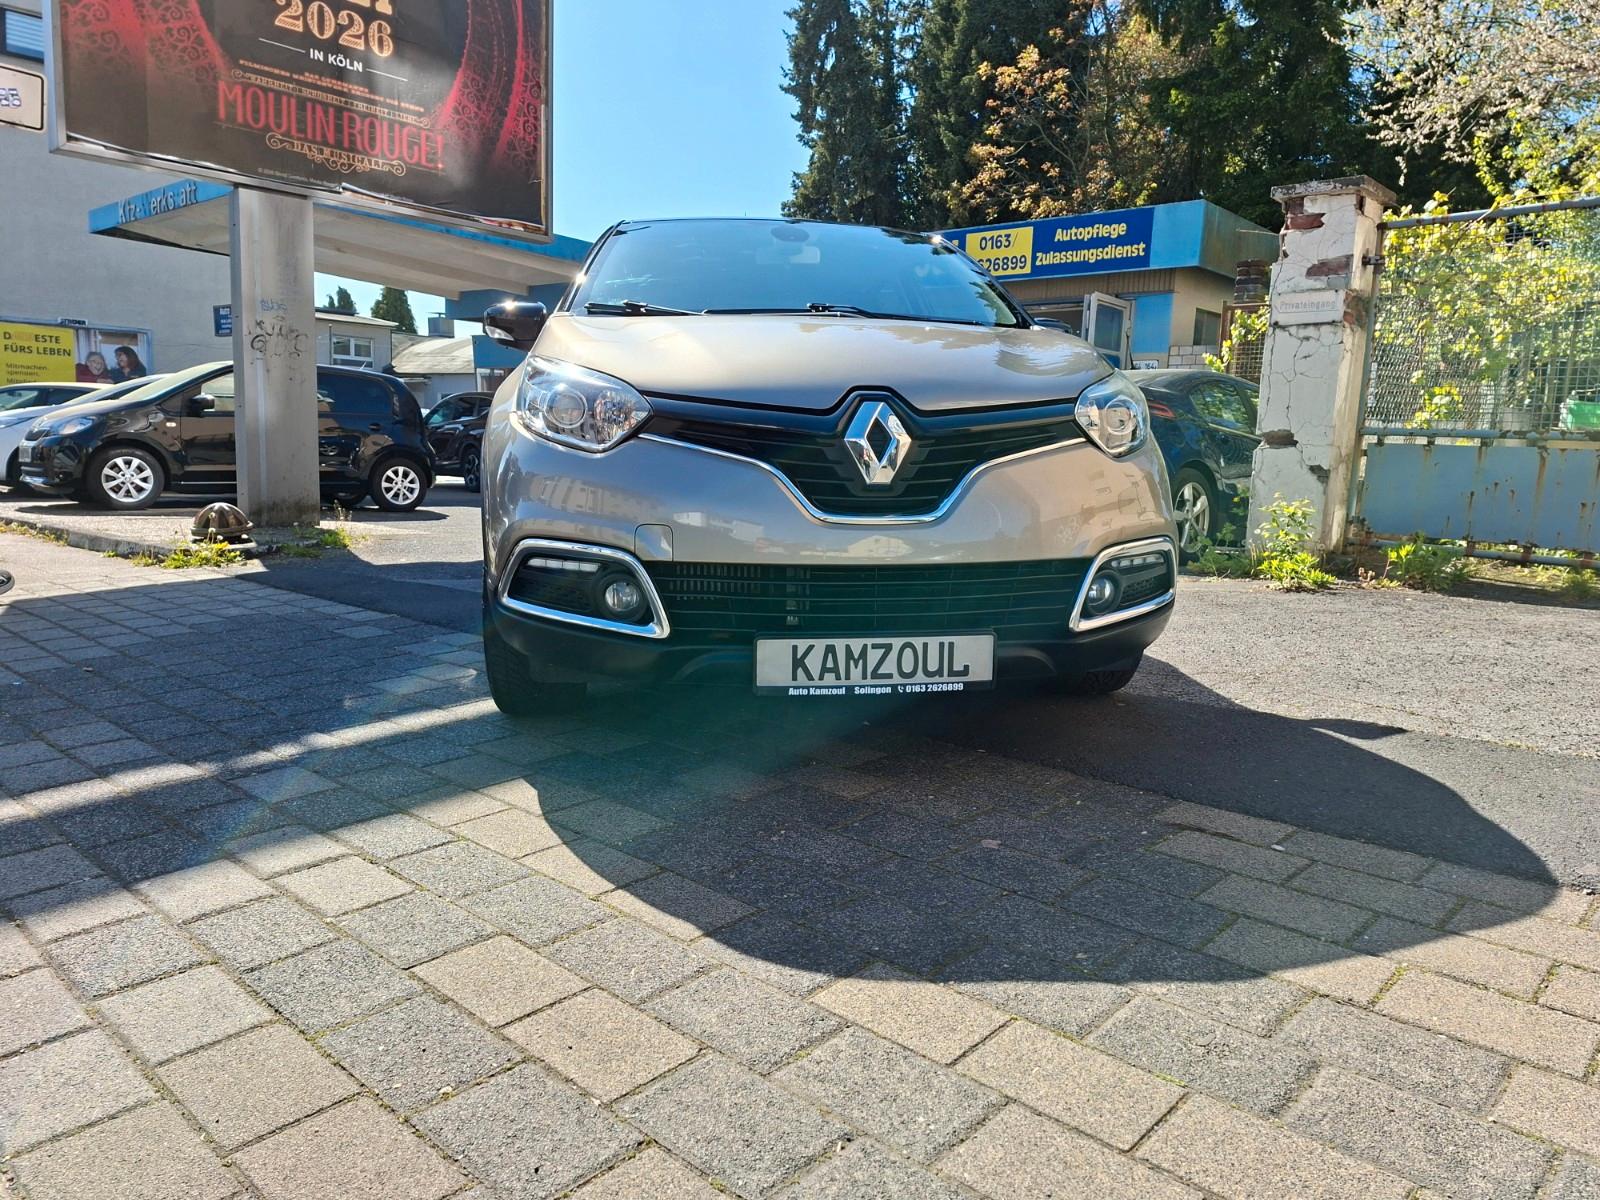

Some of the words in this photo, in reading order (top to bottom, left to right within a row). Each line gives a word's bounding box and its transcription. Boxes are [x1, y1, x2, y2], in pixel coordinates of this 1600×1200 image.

[274, 0, 394, 57] 2026
[309, 48, 324, 62] IN
[327, 53, 363, 72] KÖLN
[217, 80, 335, 145] MOULIN
[342, 110, 445, 170] ROUGE!
[294, 140, 318, 155] DAS
[324, 146, 382, 169] MUSICAL
[1054, 222, 1127, 242] Autopflege
[1035, 240, 1146, 266] Zulassungsdienst
[3, 342, 33, 354] FÜRS
[36, 346, 72, 357] LEBEN
[34, 334, 61, 344] ESTE
[791, 641, 970, 682] KAMZOUL
[788, 687, 808, 696] Auto
[809, 686, 846, 696] Kamzoul
[905, 683, 926, 693] 0163
